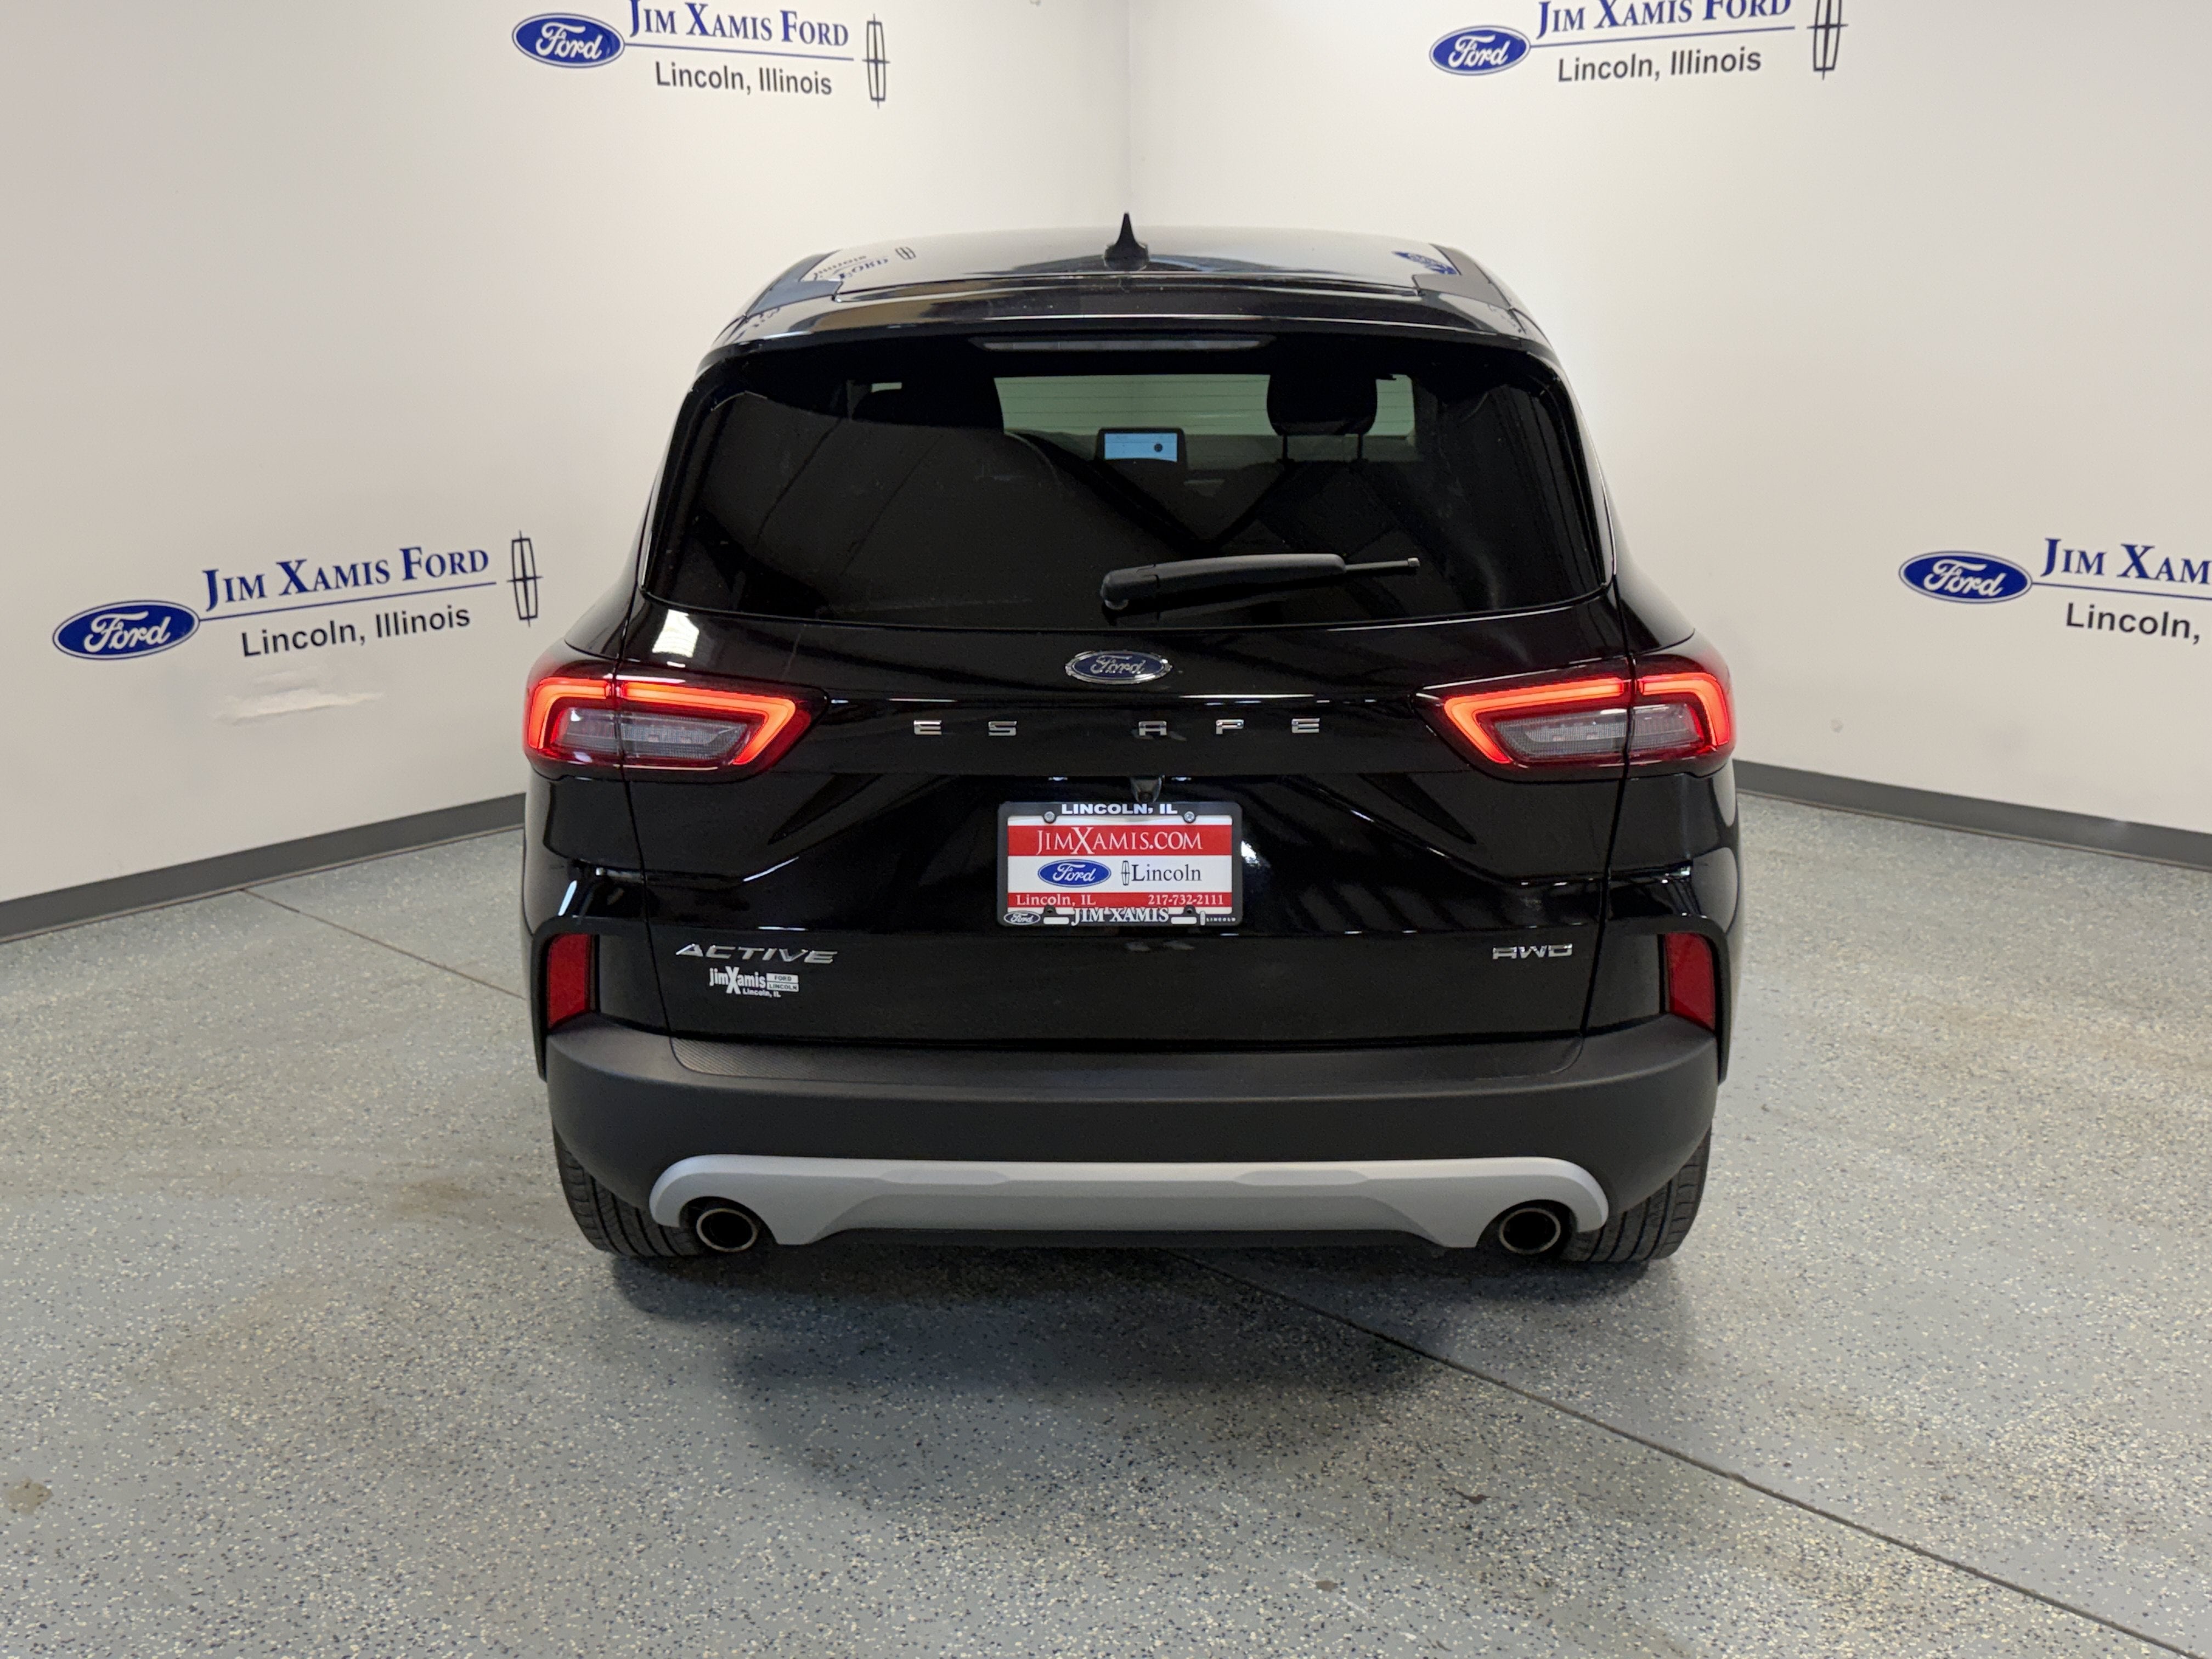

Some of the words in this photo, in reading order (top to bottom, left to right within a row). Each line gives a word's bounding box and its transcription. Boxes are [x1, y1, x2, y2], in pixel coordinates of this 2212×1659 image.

[630, 0, 675, 37] JIM
[685, 2, 772, 41] XAMIS
[780, 10, 848, 46] FORD
[1537, 1, 1584, 40] JIM
[535, 22, 602, 60] Ford
[1448, 35, 1508, 68] Ford
[655, 61, 751, 94] Lincoln,
[759, 67, 832, 95] Illinois
[1558, 56, 1660, 82] Lincoln,
[1671, 47, 1761, 75] Illinois
[2041, 538, 2106, 577] JIM
[202, 569, 266, 612] JIM
[276, 559, 391, 596] XAMIS
[400, 547, 488, 580] FORD
[1923, 559, 2006, 597] Ford
[83, 611, 170, 652] Ford
[241, 620, 365, 657] Lincoln,
[376, 605, 470, 638] Illinois
[2066, 602, 2199, 645] Lincoln,
[1090, 656, 1146, 674] Ford
[1062, 804, 1153, 815] LINCOLN,
[1159, 804, 1177, 814] IL
[1053, 864, 1096, 883] Ford
[1131, 864, 1201, 881] Lincoln
[1016, 894, 1075, 906] Lincoln,
[1081, 894, 1096, 905] IL
[1148, 894, 1223, 905] 217-732-2111
[1071, 907, 1101, 926] JIM
[1108, 907, 1169, 922] XAMIS
[675, 943, 837, 964] ACTIVE
[1492, 944, 1573, 960] AWD
[742, 988, 772, 998] Lincoln,
